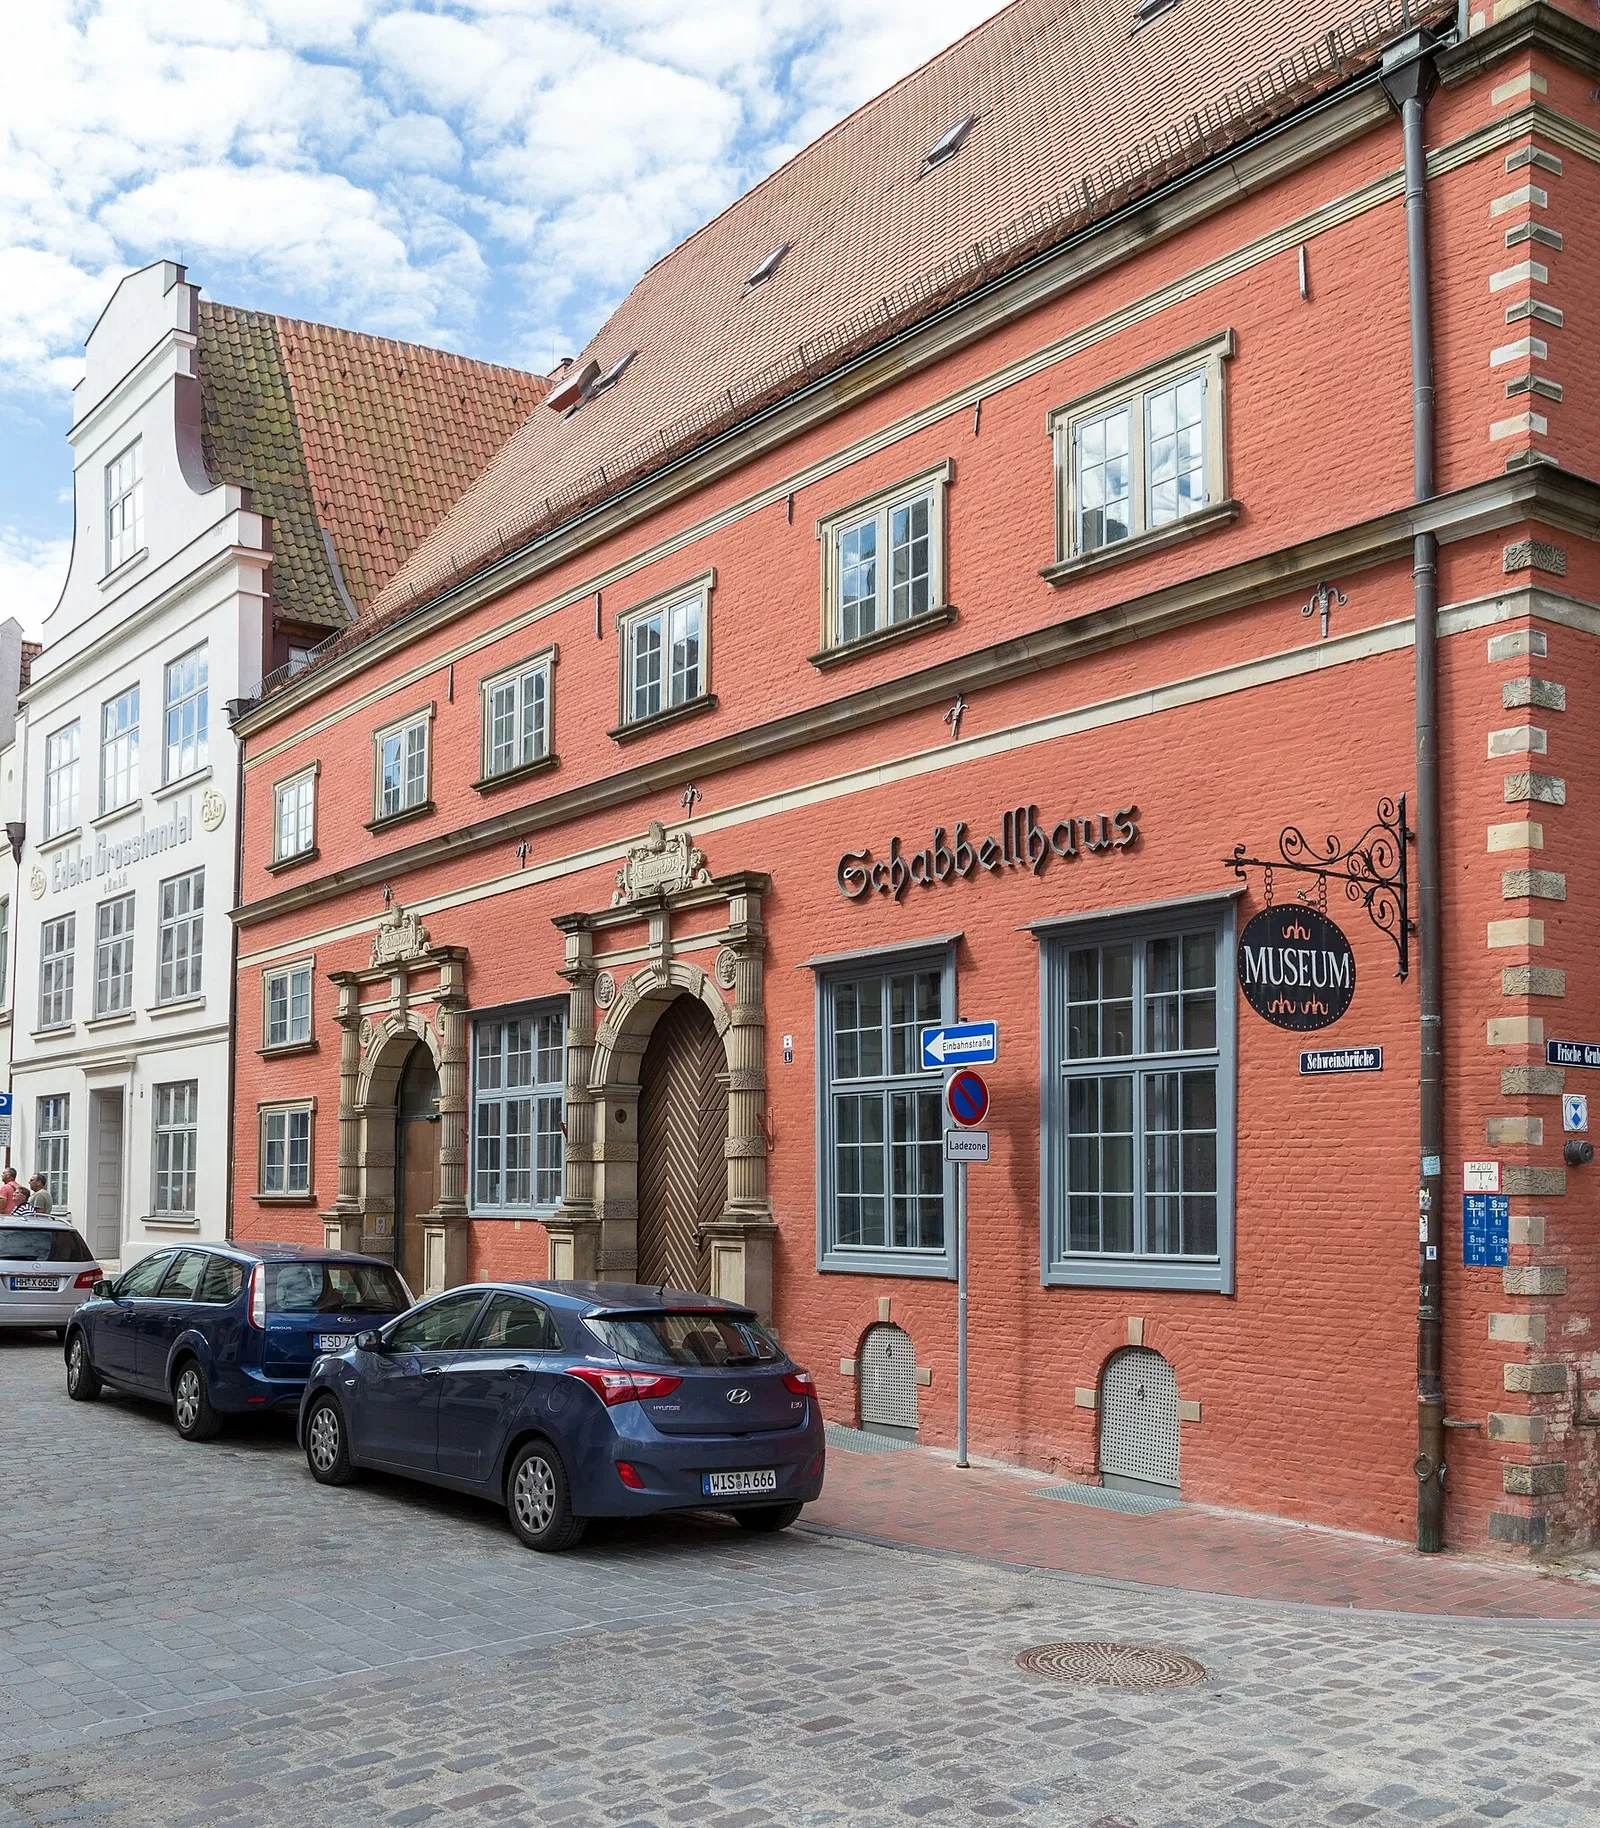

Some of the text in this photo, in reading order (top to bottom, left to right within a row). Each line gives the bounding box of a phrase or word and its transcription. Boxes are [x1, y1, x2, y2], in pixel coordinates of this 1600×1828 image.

[51, 795, 193, 894] Edeka Grosshandel
[836, 804, 1142, 902] Schabbellhaus
[1243, 945, 1350, 989] MUSEUM
[942, 1037, 991, 1051] Einbahnstraße
[1307, 1050, 1375, 1070] Schweinsbrücke
[1557, 1044, 1582, 1063] Frische
[949, 1140, 987, 1151] Ladezone
[16, 1278, 28, 1287] HH
[31, 1278, 37, 1287] X
[320, 1335, 341, 1348] FSD
[711, 1472, 775, 1490] WIS A 666
